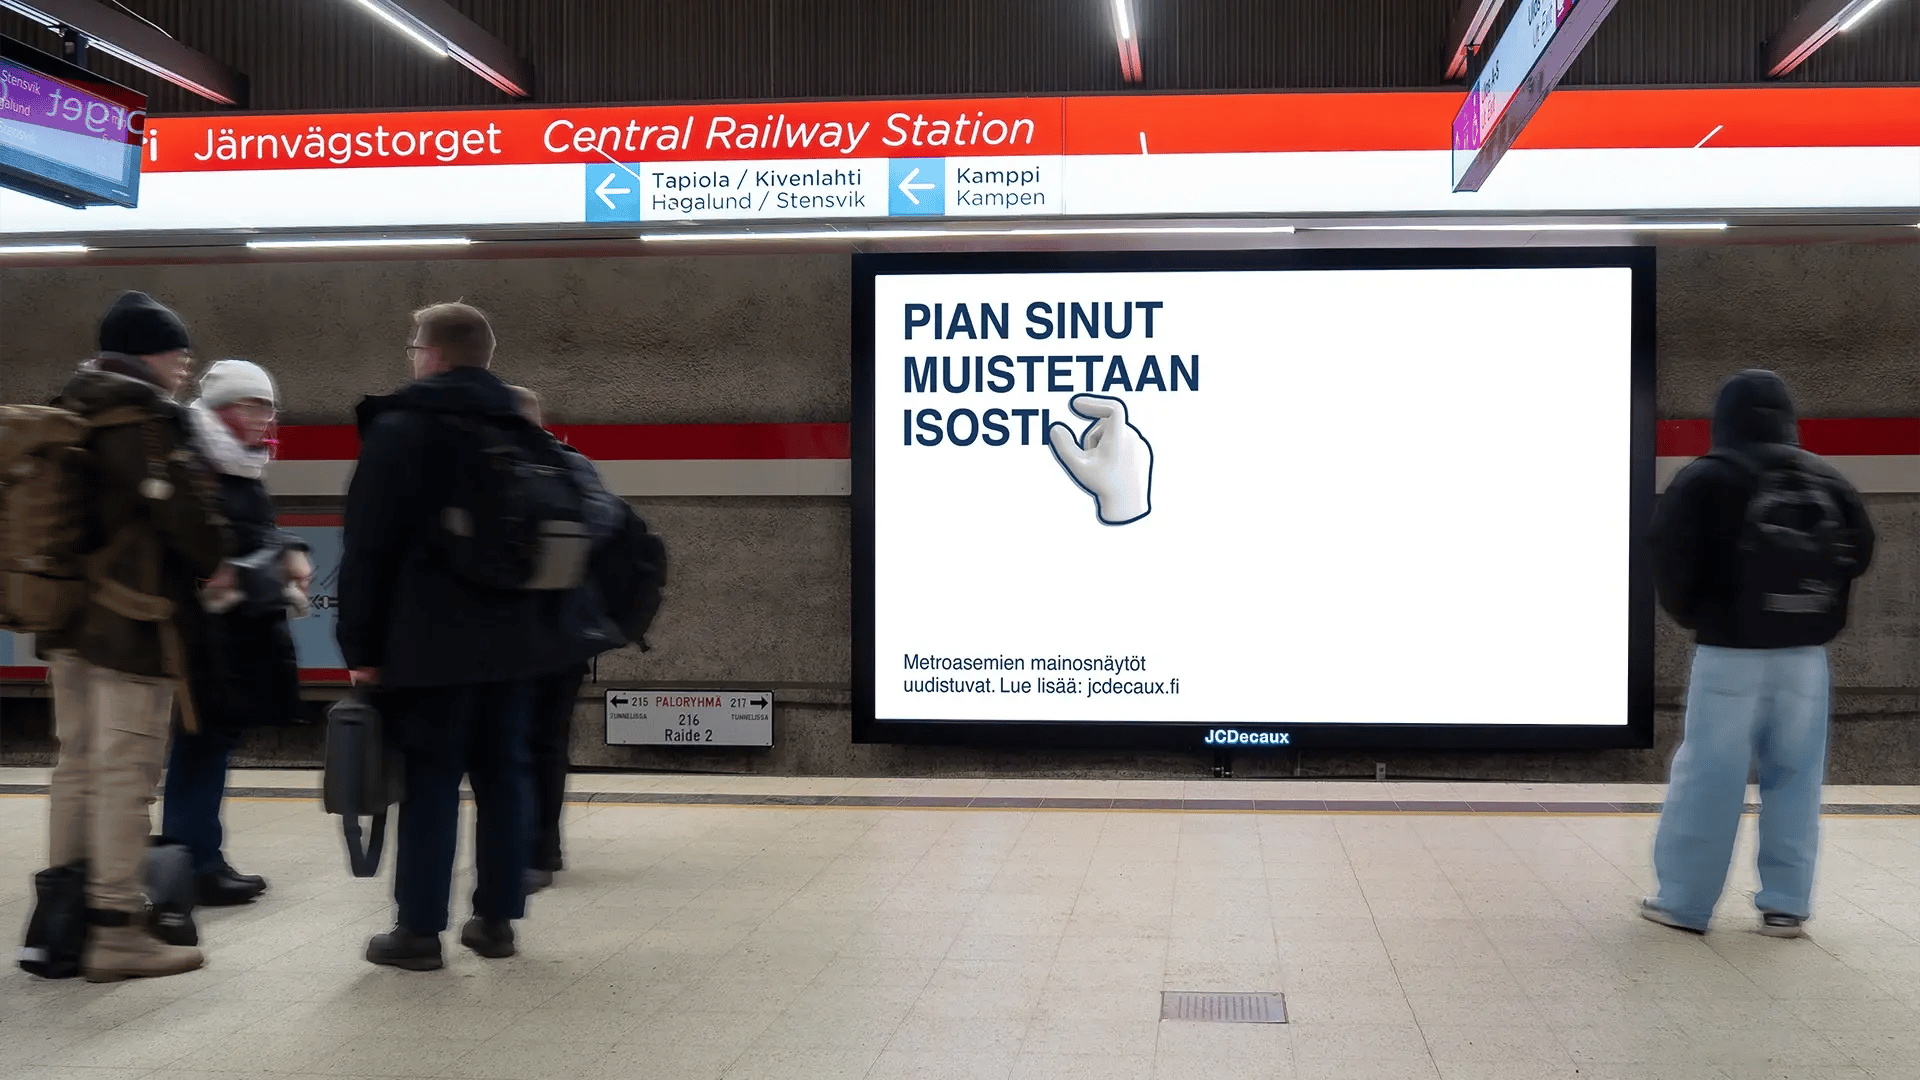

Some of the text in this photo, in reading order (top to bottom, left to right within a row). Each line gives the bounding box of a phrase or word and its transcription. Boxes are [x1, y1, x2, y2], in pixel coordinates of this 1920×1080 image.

[1, 69, 41, 95] Stensvik
[193, 123, 502, 165] Järnvägstorget
[543, 115, 695, 153] Central
[705, 113, 870, 155] Railway
[881, 111, 1035, 148] Station
[651, 168, 861, 192] Tapiola / Kivenlahti
[957, 167, 1040, 187] Kamppi
[652, 190, 865, 214] Hagalund / Stensvik
[957, 189, 1045, 209] Kampen
[904, 301, 1164, 340] PIAN SINUT
[904, 354, 1200, 393] MUISTETAAN
[903, 408, 1050, 447] ISOSTI
[904, 654, 1146, 675] Metroasemien mainosnäytöt
[903, 677, 1179, 698] uudistuvat. Lue lisää: jcdecaux.fi
[631, 695, 747, 708] 215 PALORYHMÄ 217
[678, 713, 700, 726] 216
[731, 713, 769, 721] TUNNELISSA
[664, 728, 713, 742] Raide 2
[1204, 729, 1290, 745] JCDecaux
